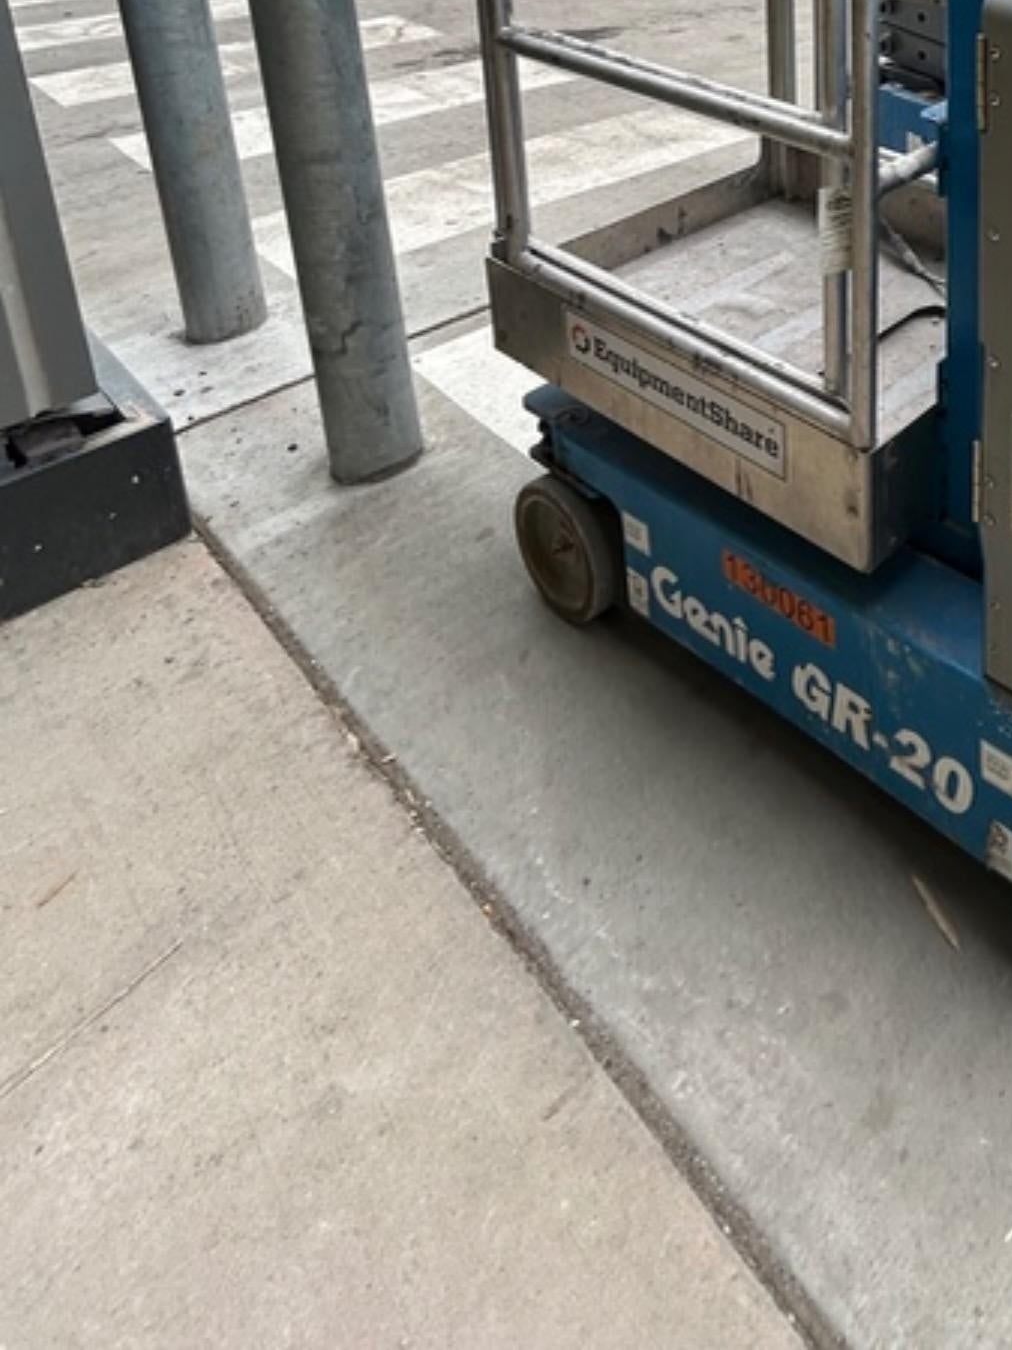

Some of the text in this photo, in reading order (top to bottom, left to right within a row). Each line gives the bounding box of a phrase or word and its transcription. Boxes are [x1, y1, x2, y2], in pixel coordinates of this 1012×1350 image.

[594, 338, 780, 457] EquipmentShare
[651, 566, 776, 682] Genie
[791, 662, 974, 815] GR-20
